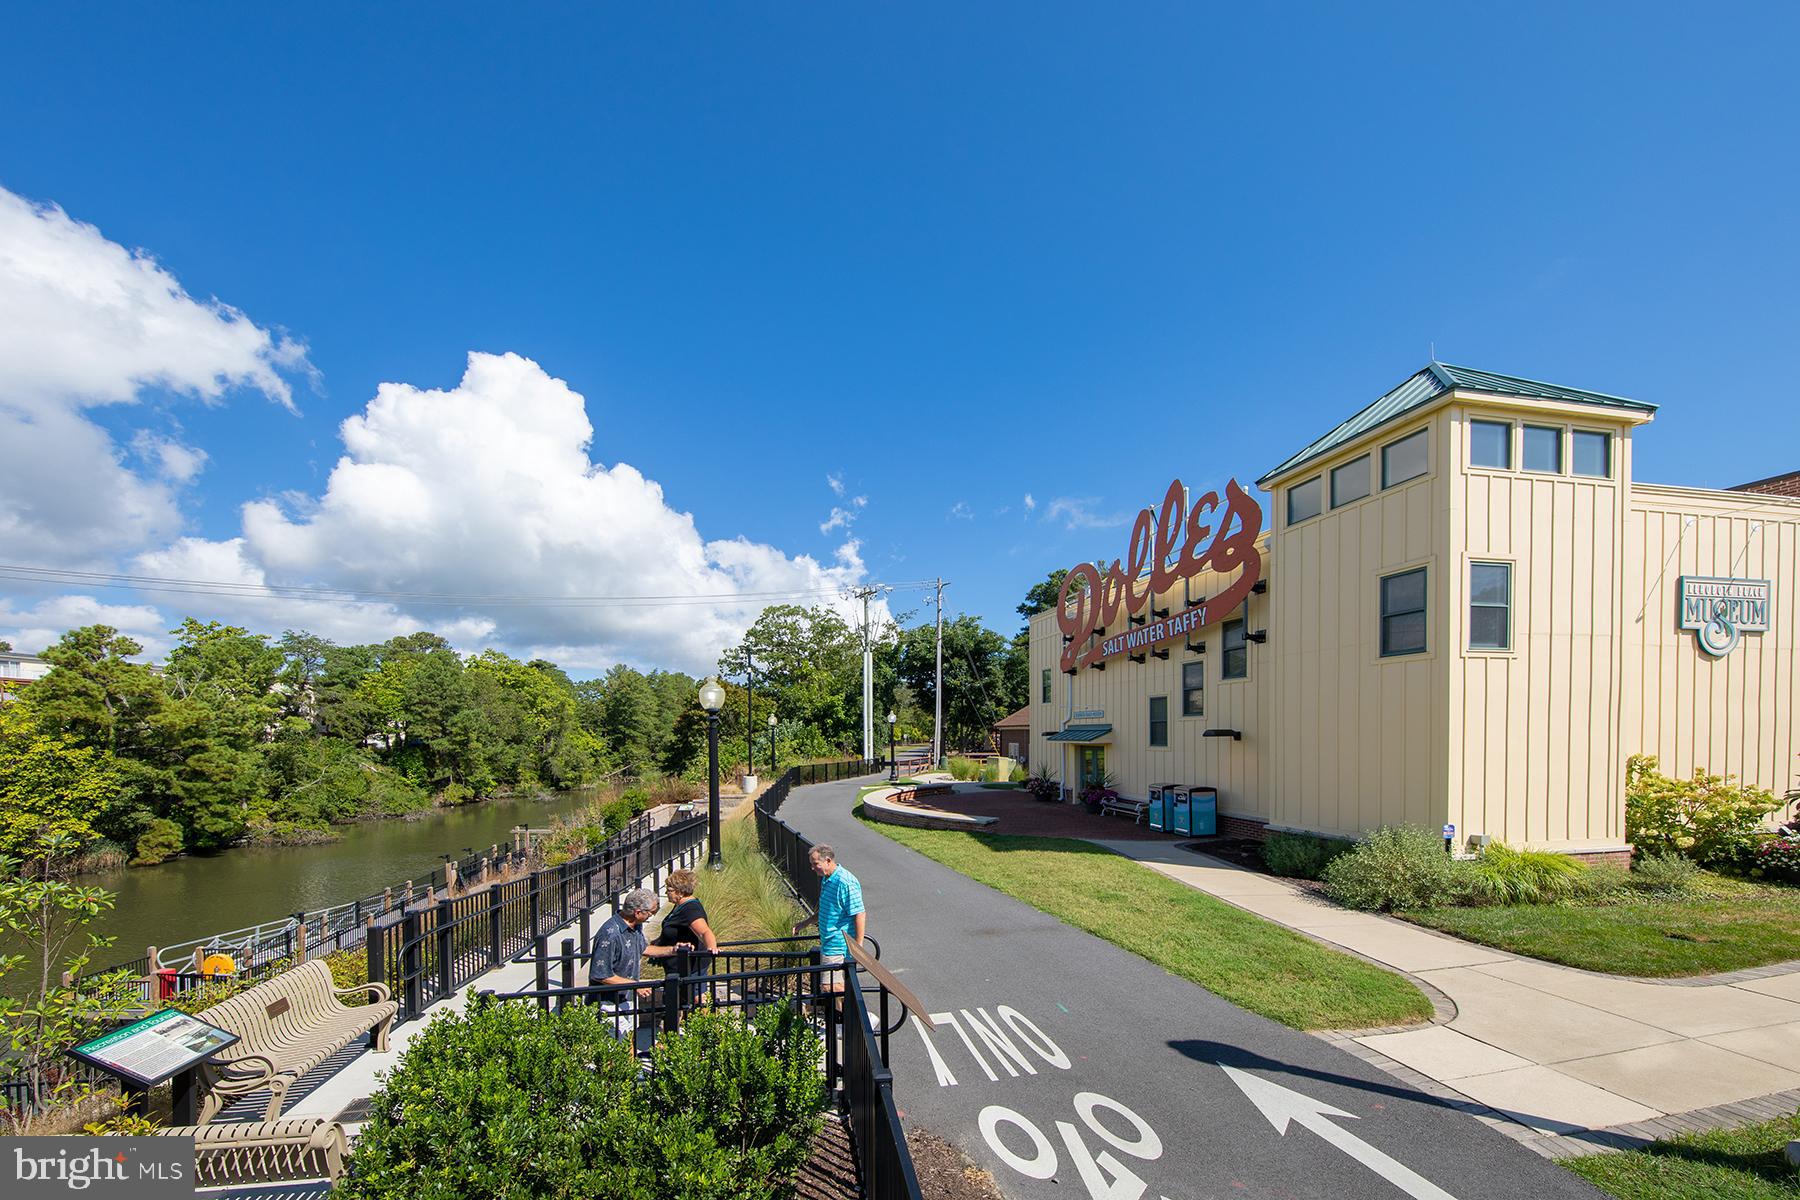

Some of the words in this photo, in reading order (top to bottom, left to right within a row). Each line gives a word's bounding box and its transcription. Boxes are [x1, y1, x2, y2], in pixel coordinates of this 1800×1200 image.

[1057, 478, 1262, 673] Dolles
[1102, 636, 1124, 656] SALT
[1126, 623, 1165, 649] WATER
[1167, 607, 1207, 637] TAFFY
[1685, 597, 1766, 650] MUSEUM
[82, 1031, 132, 1052] Recreation
[131, 1023, 149, 1035] and
[146, 1011, 179, 1026] Tourism
[911, 1004, 1072, 1087] ONLY
